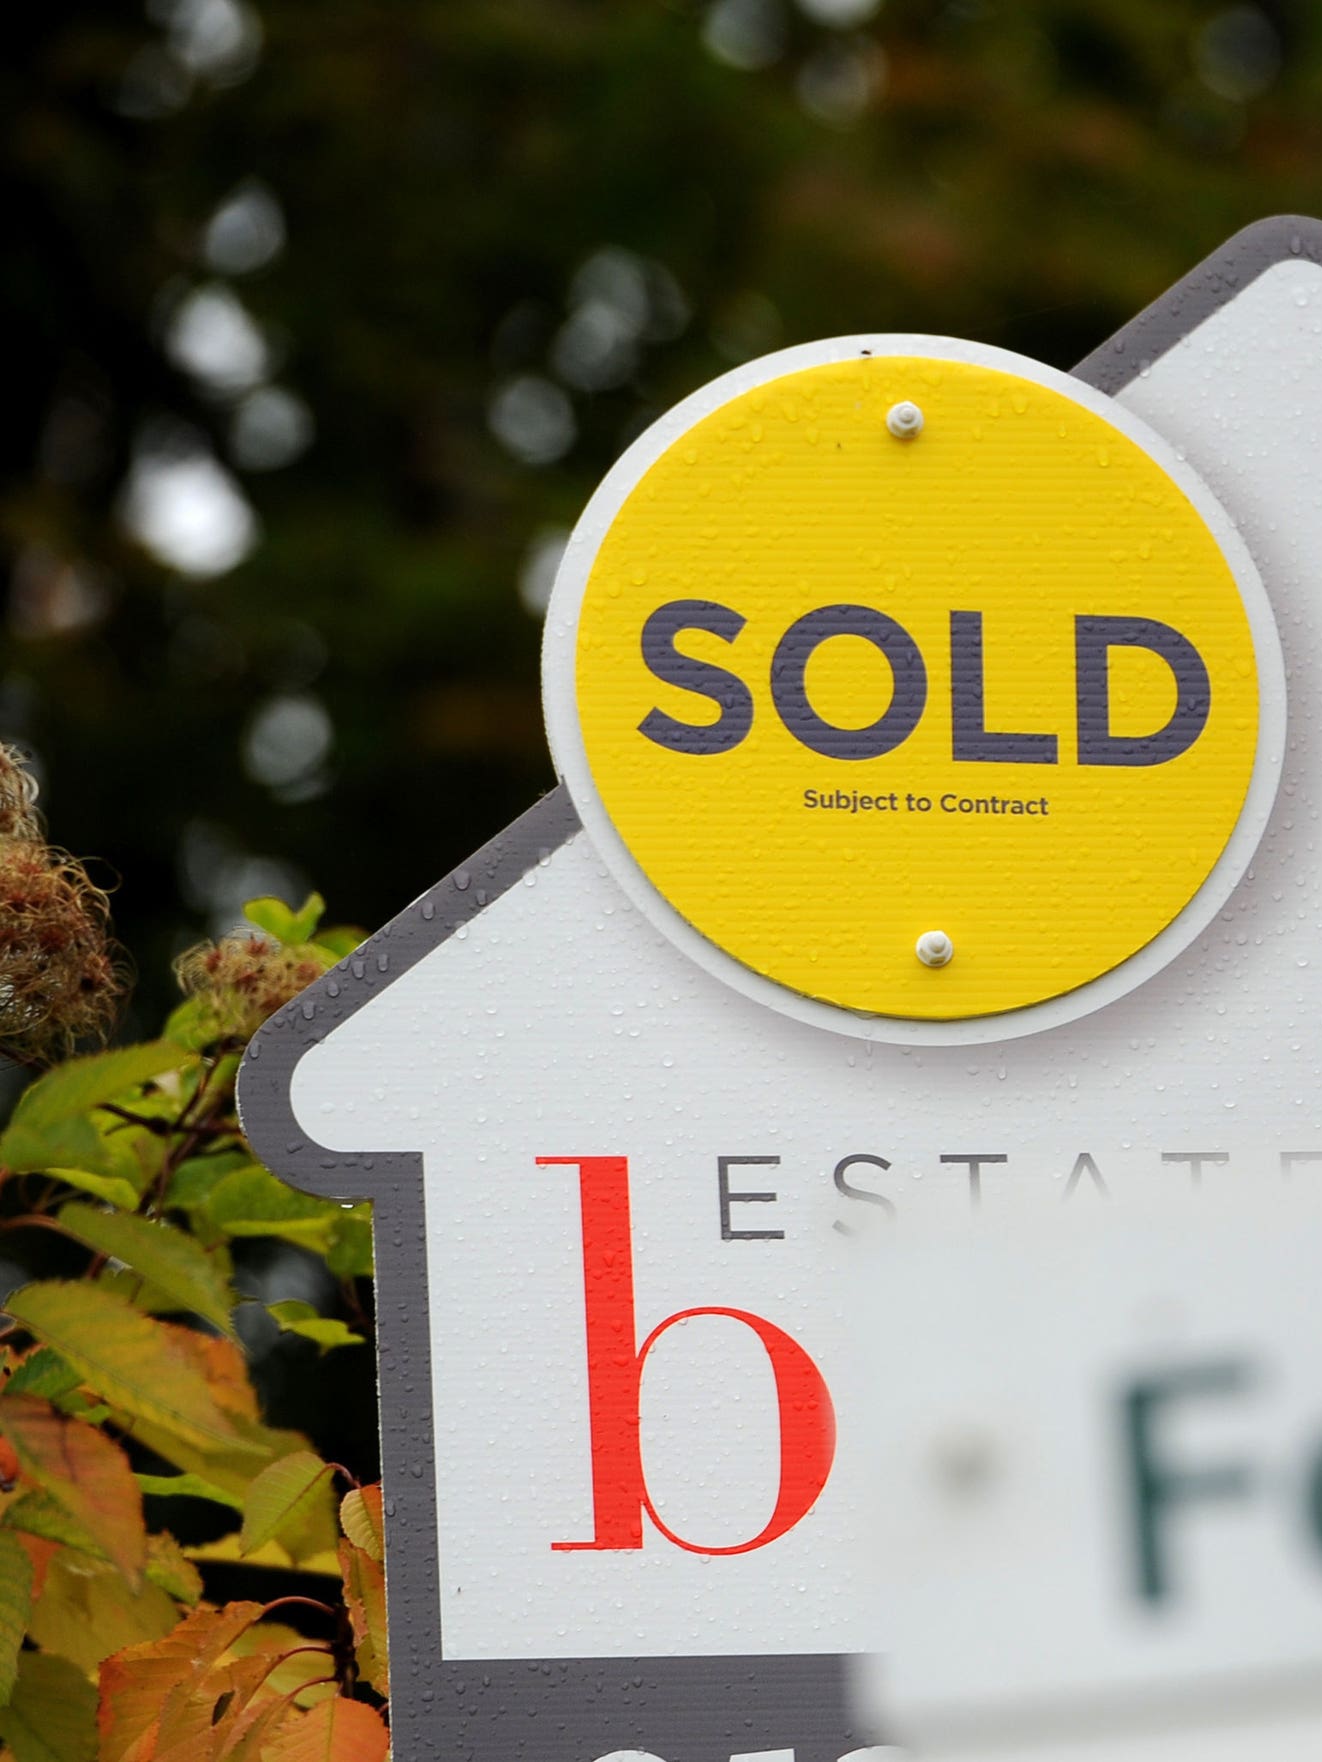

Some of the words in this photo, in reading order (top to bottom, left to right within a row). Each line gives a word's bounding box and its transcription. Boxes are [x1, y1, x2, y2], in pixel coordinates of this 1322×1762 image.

[637, 599, 1212, 767] SOLD
[803, 789, 898, 814] Subject
[905, 793, 932, 812] to
[940, 794, 1050, 816] Contract
[535, 1155, 837, 1556] b
